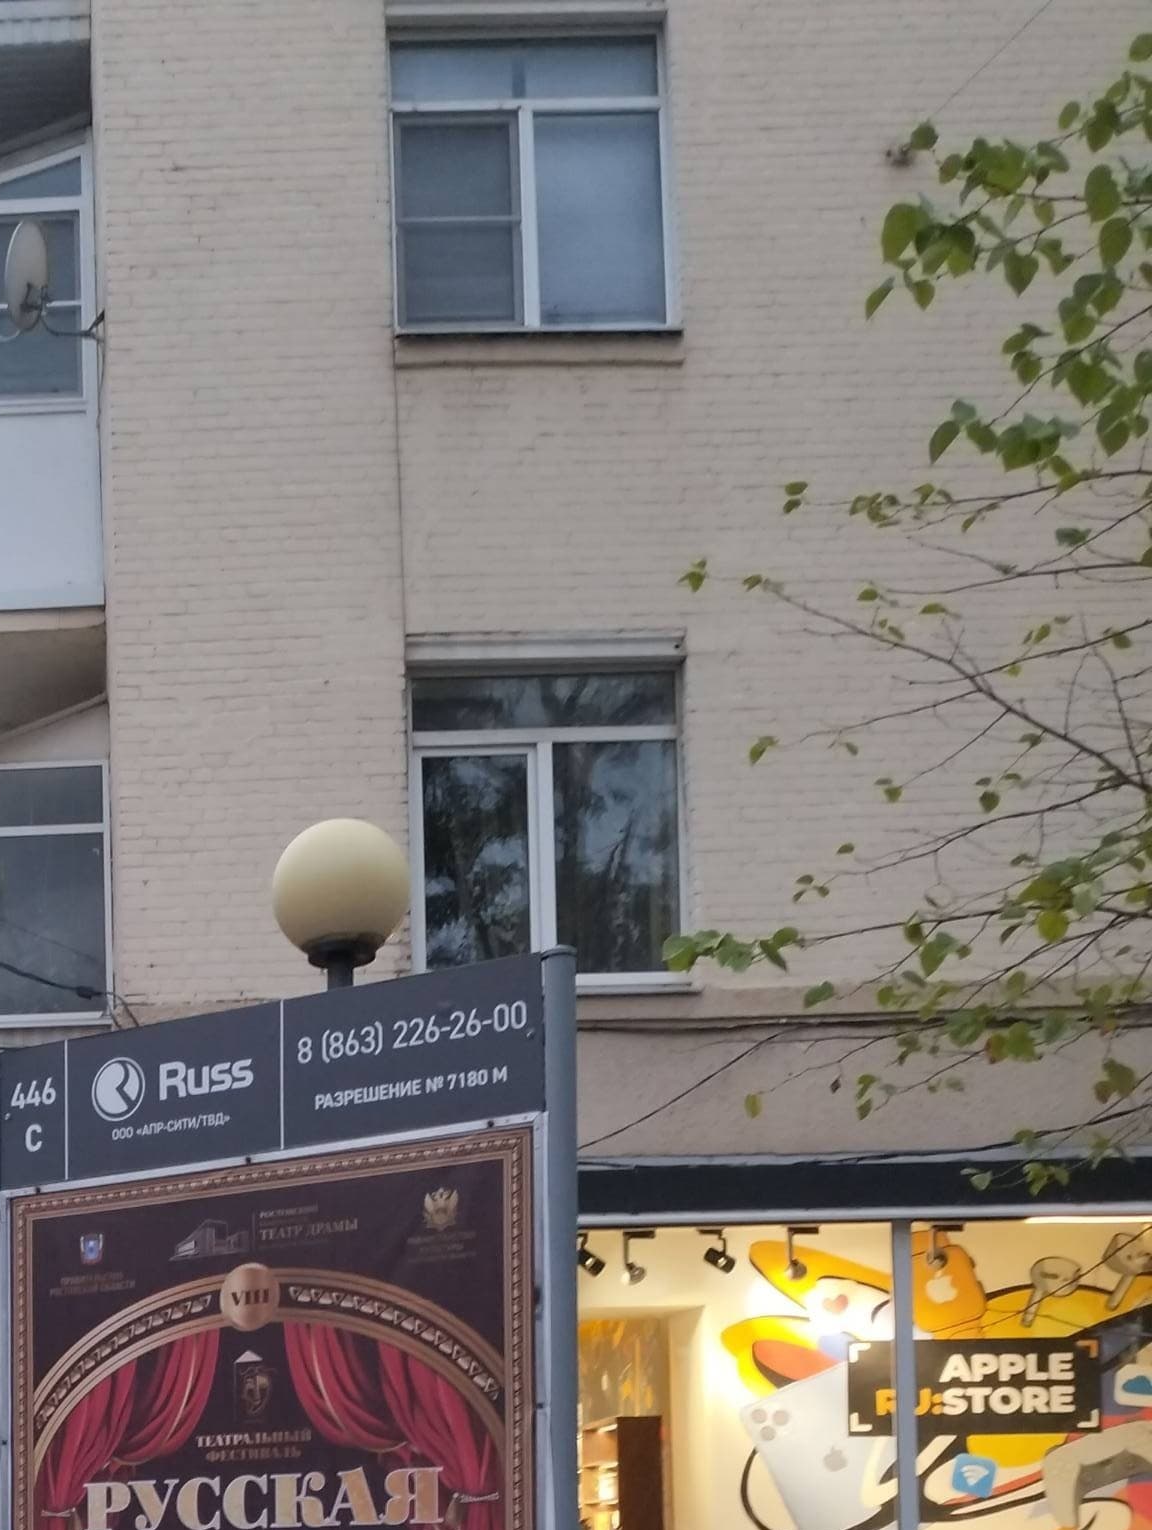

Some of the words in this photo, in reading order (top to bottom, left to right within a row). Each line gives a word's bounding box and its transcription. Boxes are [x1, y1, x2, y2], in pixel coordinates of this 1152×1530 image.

[297, 1036, 313, 1065] 8
[321, 1021, 384, 1061] (863)
[392, 1000, 528, 1050] 226-26-00
[10, 1077, 57, 1110] 446
[158, 1057, 254, 1101] Russ
[314, 1078, 422, 1111] РАЗРЕШЕНИЕ
[425, 1075, 445, 1094] №
[447, 1068, 489, 1091] 7180
[492, 1066, 508, 1084] М
[111, 1126, 134, 1141] ООО
[135, 1112, 231, 1139] «АПР-СИТИ/ТВД»
[259, 1225, 304, 1241] ТЕАТР
[305, 1218, 359, 1237] ДРАМЫ
[231, 1288, 271, 1307] VIII
[938, 1352, 1076, 1383] APPLE
[195, 1429, 312, 1448] ТЕАТРАЛЬНЫЙ
[204, 1446, 302, 1462] ФЕСТИВАЛЬ
